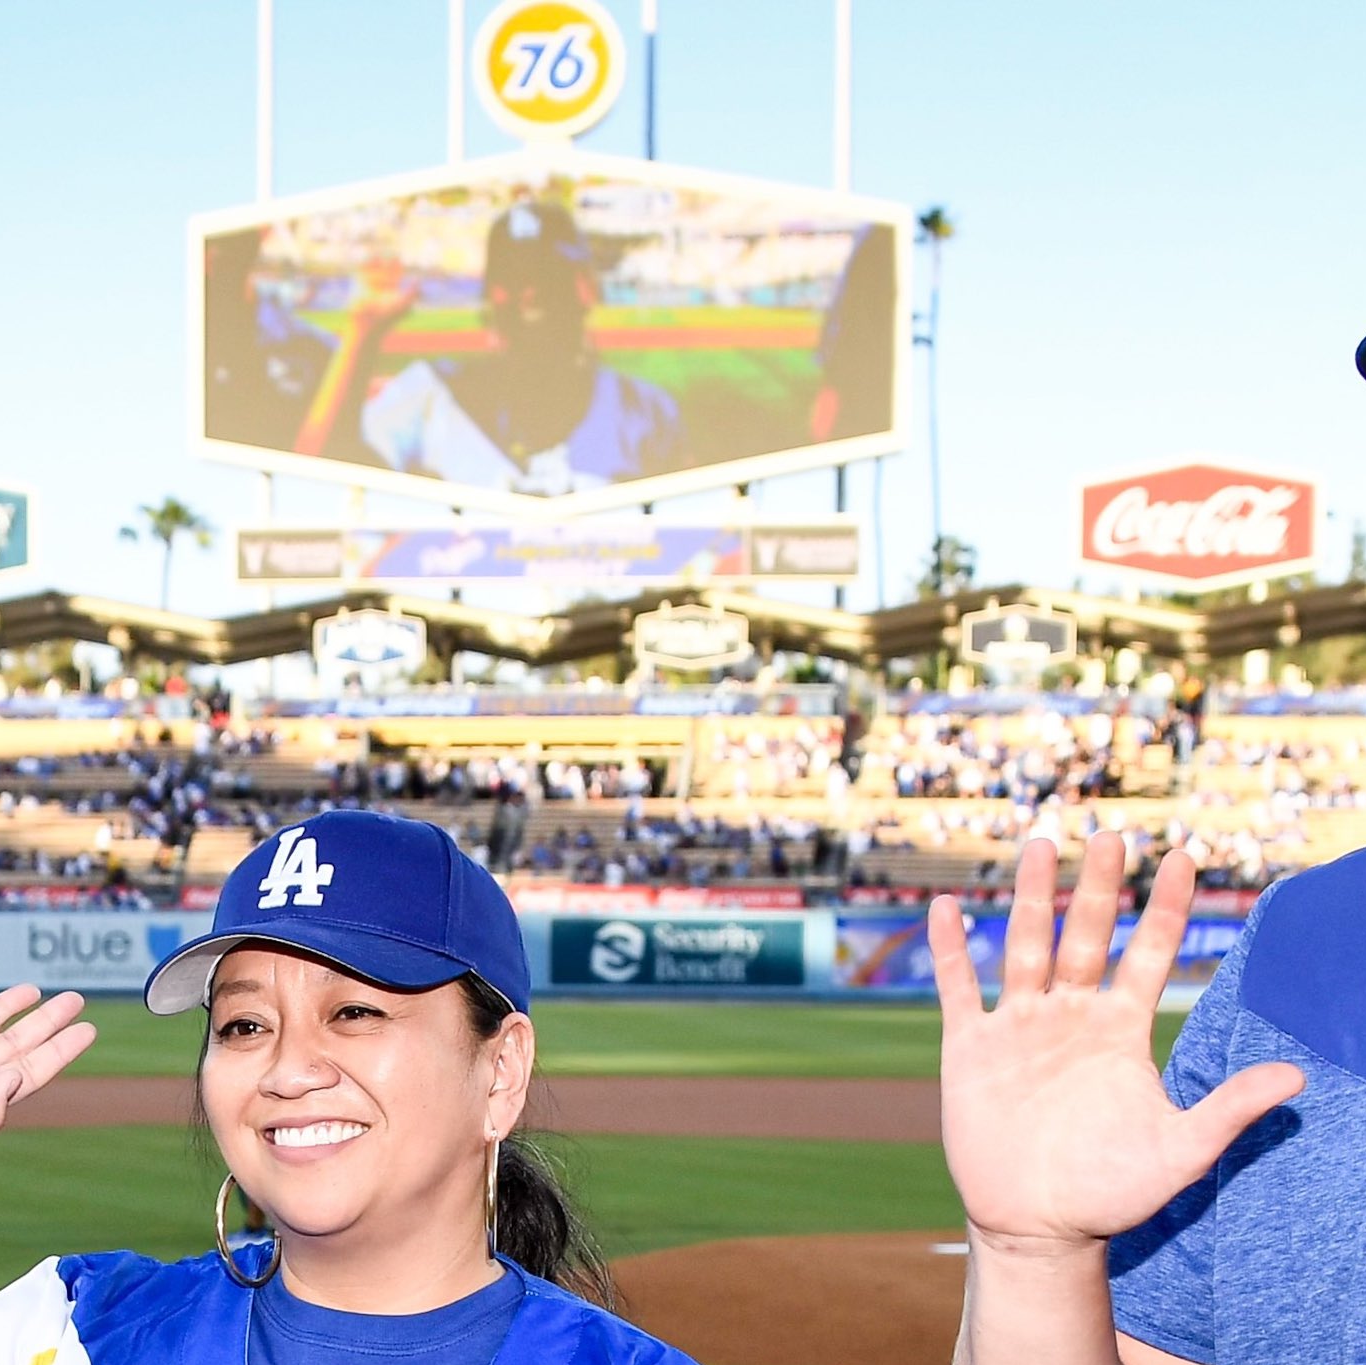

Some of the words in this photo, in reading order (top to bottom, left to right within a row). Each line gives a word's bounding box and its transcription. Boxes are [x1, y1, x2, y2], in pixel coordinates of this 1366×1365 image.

[517, 34, 587, 91] 76
[257, 826, 335, 910] LA
[28, 921, 133, 964] blue
[653, 921, 765, 960] Security
[655, 953, 747, 980] Benefit
